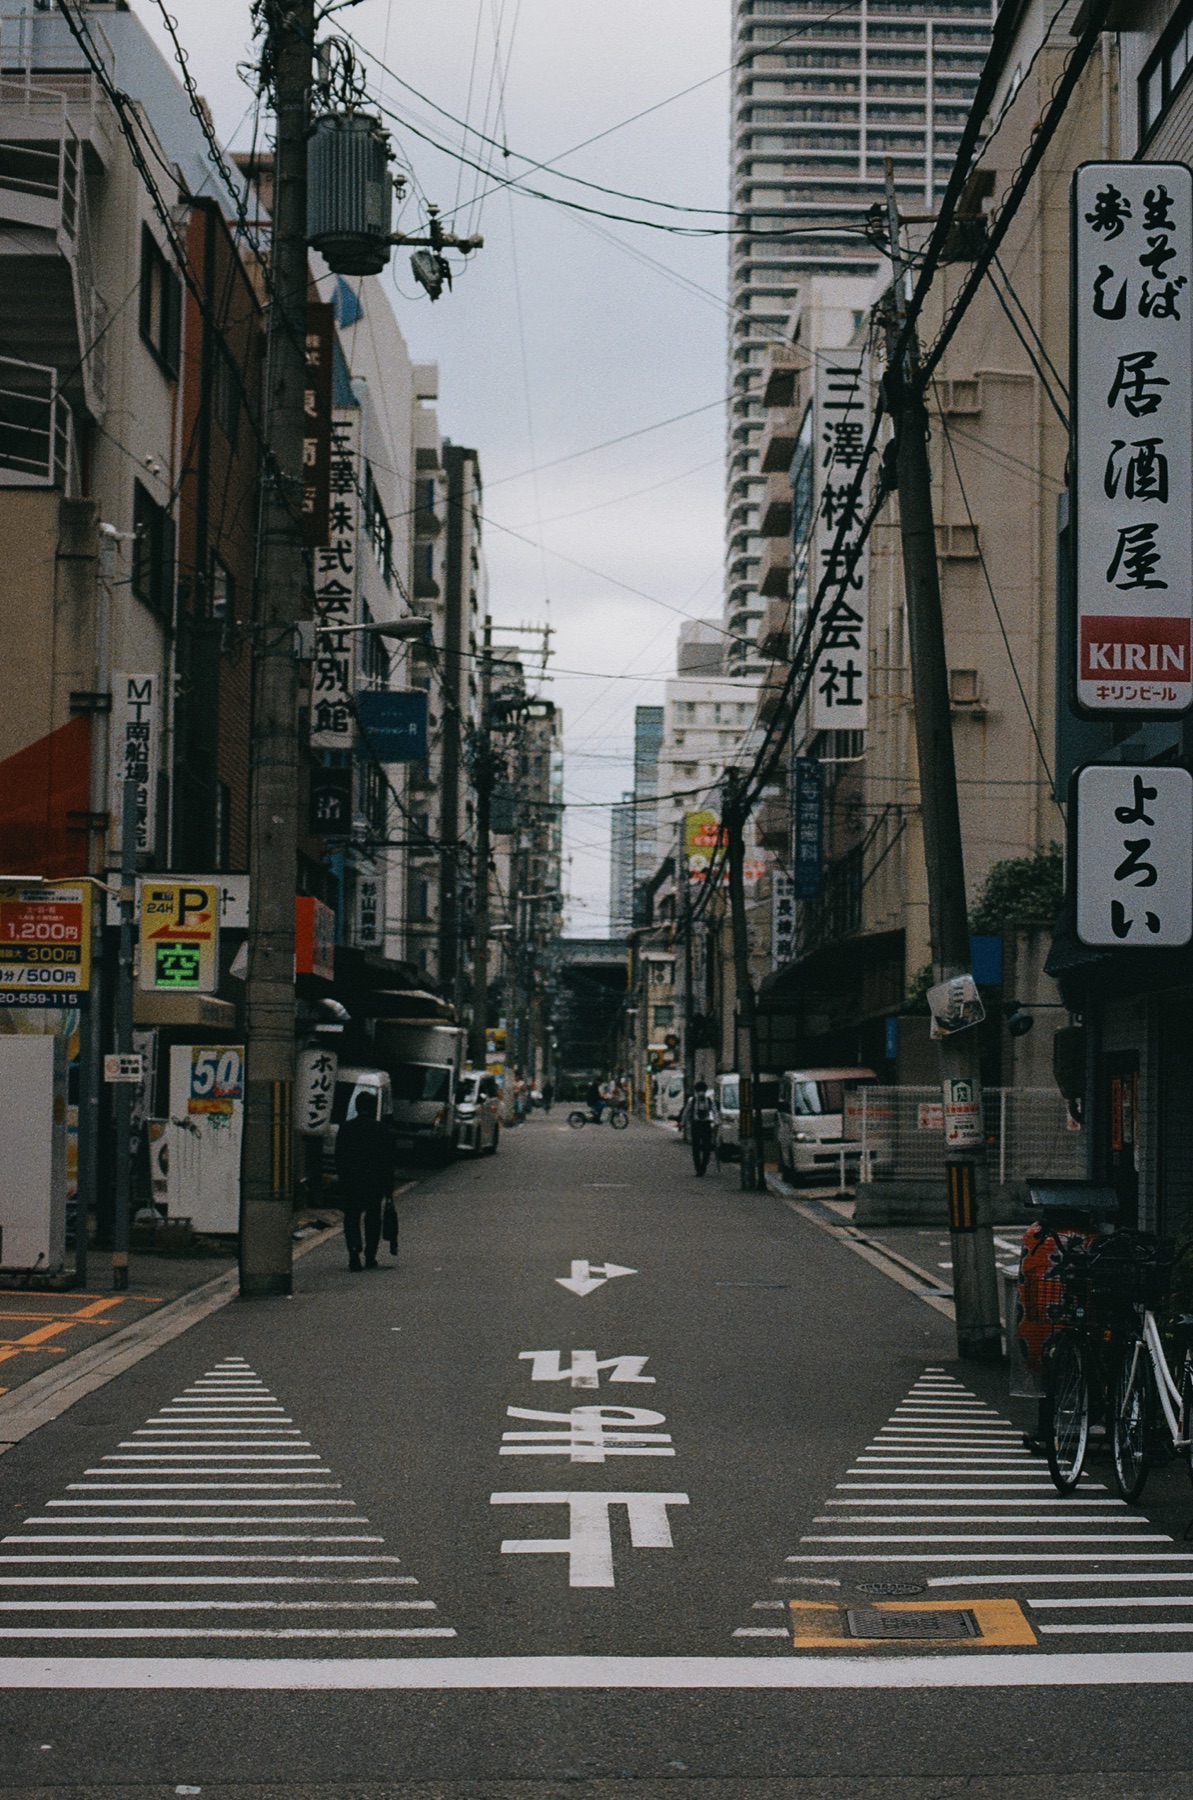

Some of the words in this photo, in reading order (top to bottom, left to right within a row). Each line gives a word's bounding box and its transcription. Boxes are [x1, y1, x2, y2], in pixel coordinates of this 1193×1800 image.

[1138, 184, 1188, 321] 生そば
[1104, 351, 1170, 591] 居酒屋
[818, 367, 865, 707] 三澤株式会社
[1089, 643, 1185, 671] KIRIN
[1096, 686, 1177, 701] キリンビール
[1111, 774, 1161, 939] よろい
[8, 922, 78, 940] 1,200円
[147, 903, 173, 913] 24H
[179, 889, 208, 926] P
[156, 943, 200, 986] 空
[308, 1054, 334, 1128] ホルモン
[490, 1350, 691, 1588] 止まれ
